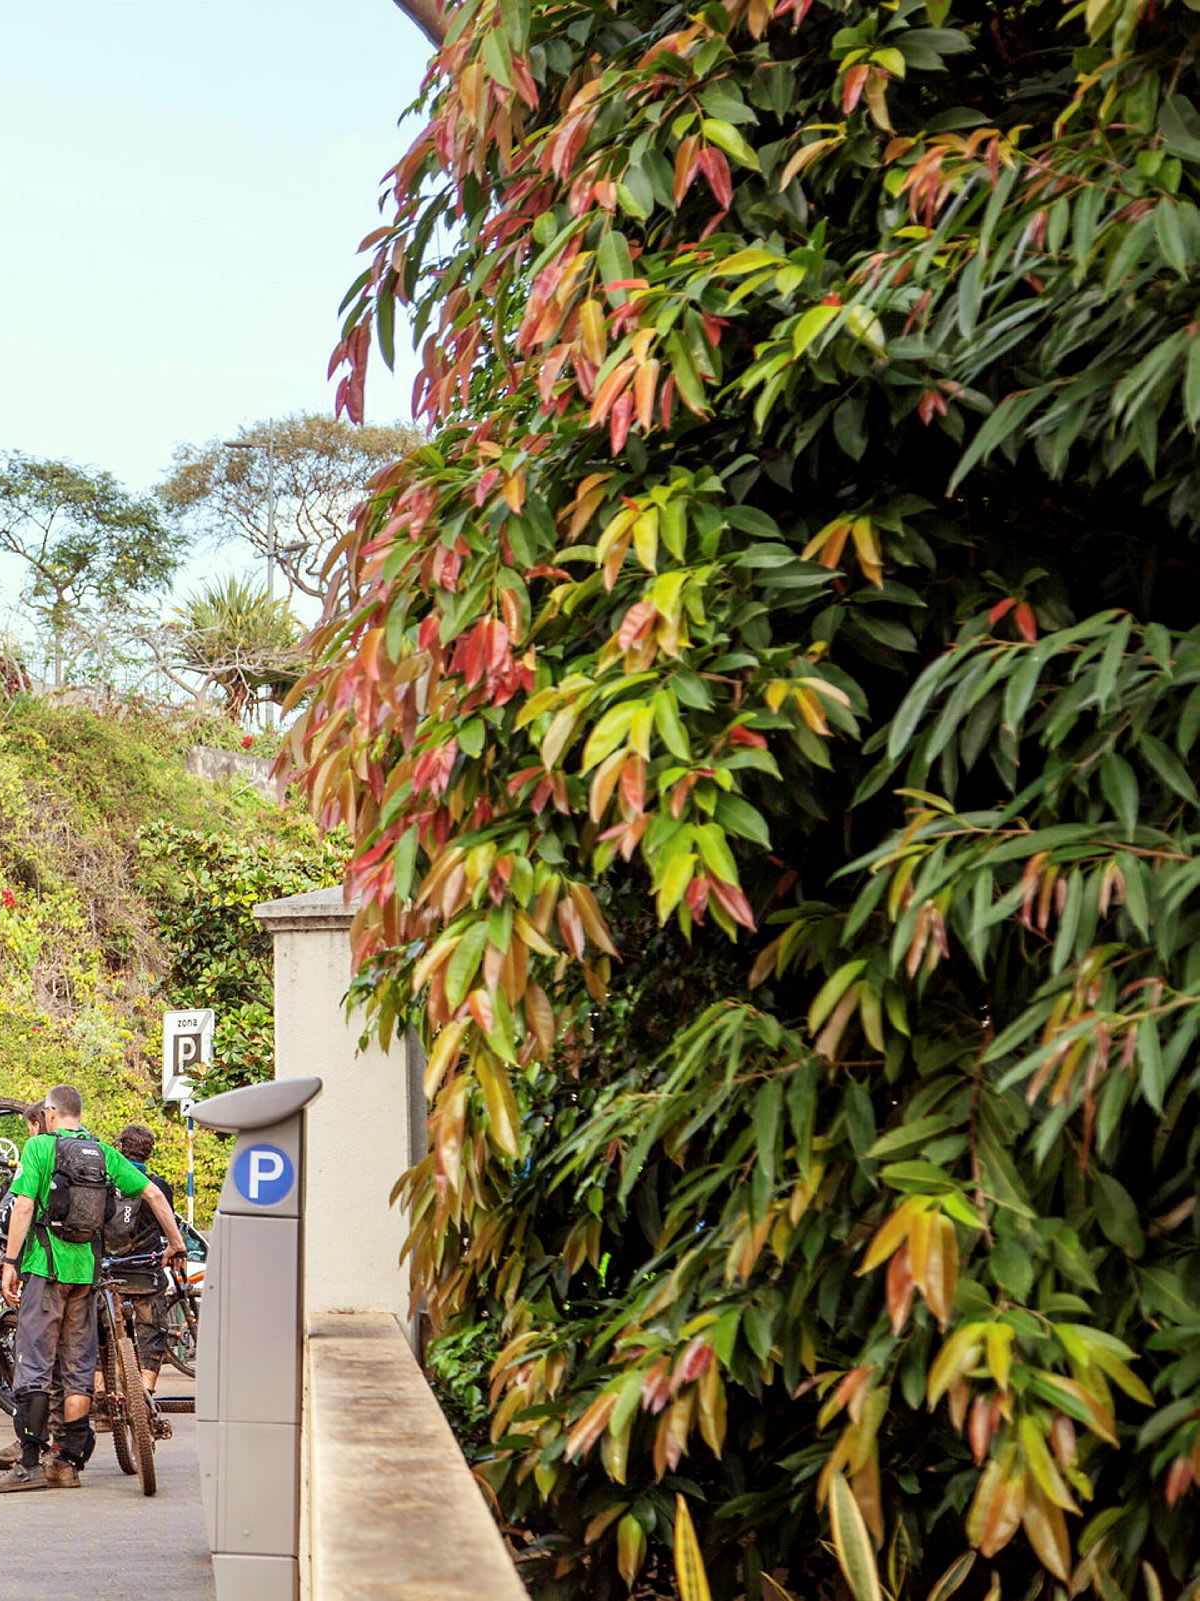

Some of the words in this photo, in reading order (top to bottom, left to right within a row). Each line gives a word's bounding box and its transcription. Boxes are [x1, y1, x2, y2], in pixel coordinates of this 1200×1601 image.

[177, 1018, 198, 1028] zona
[178, 1036, 197, 1073] P
[248, 1150, 284, 1199] P
